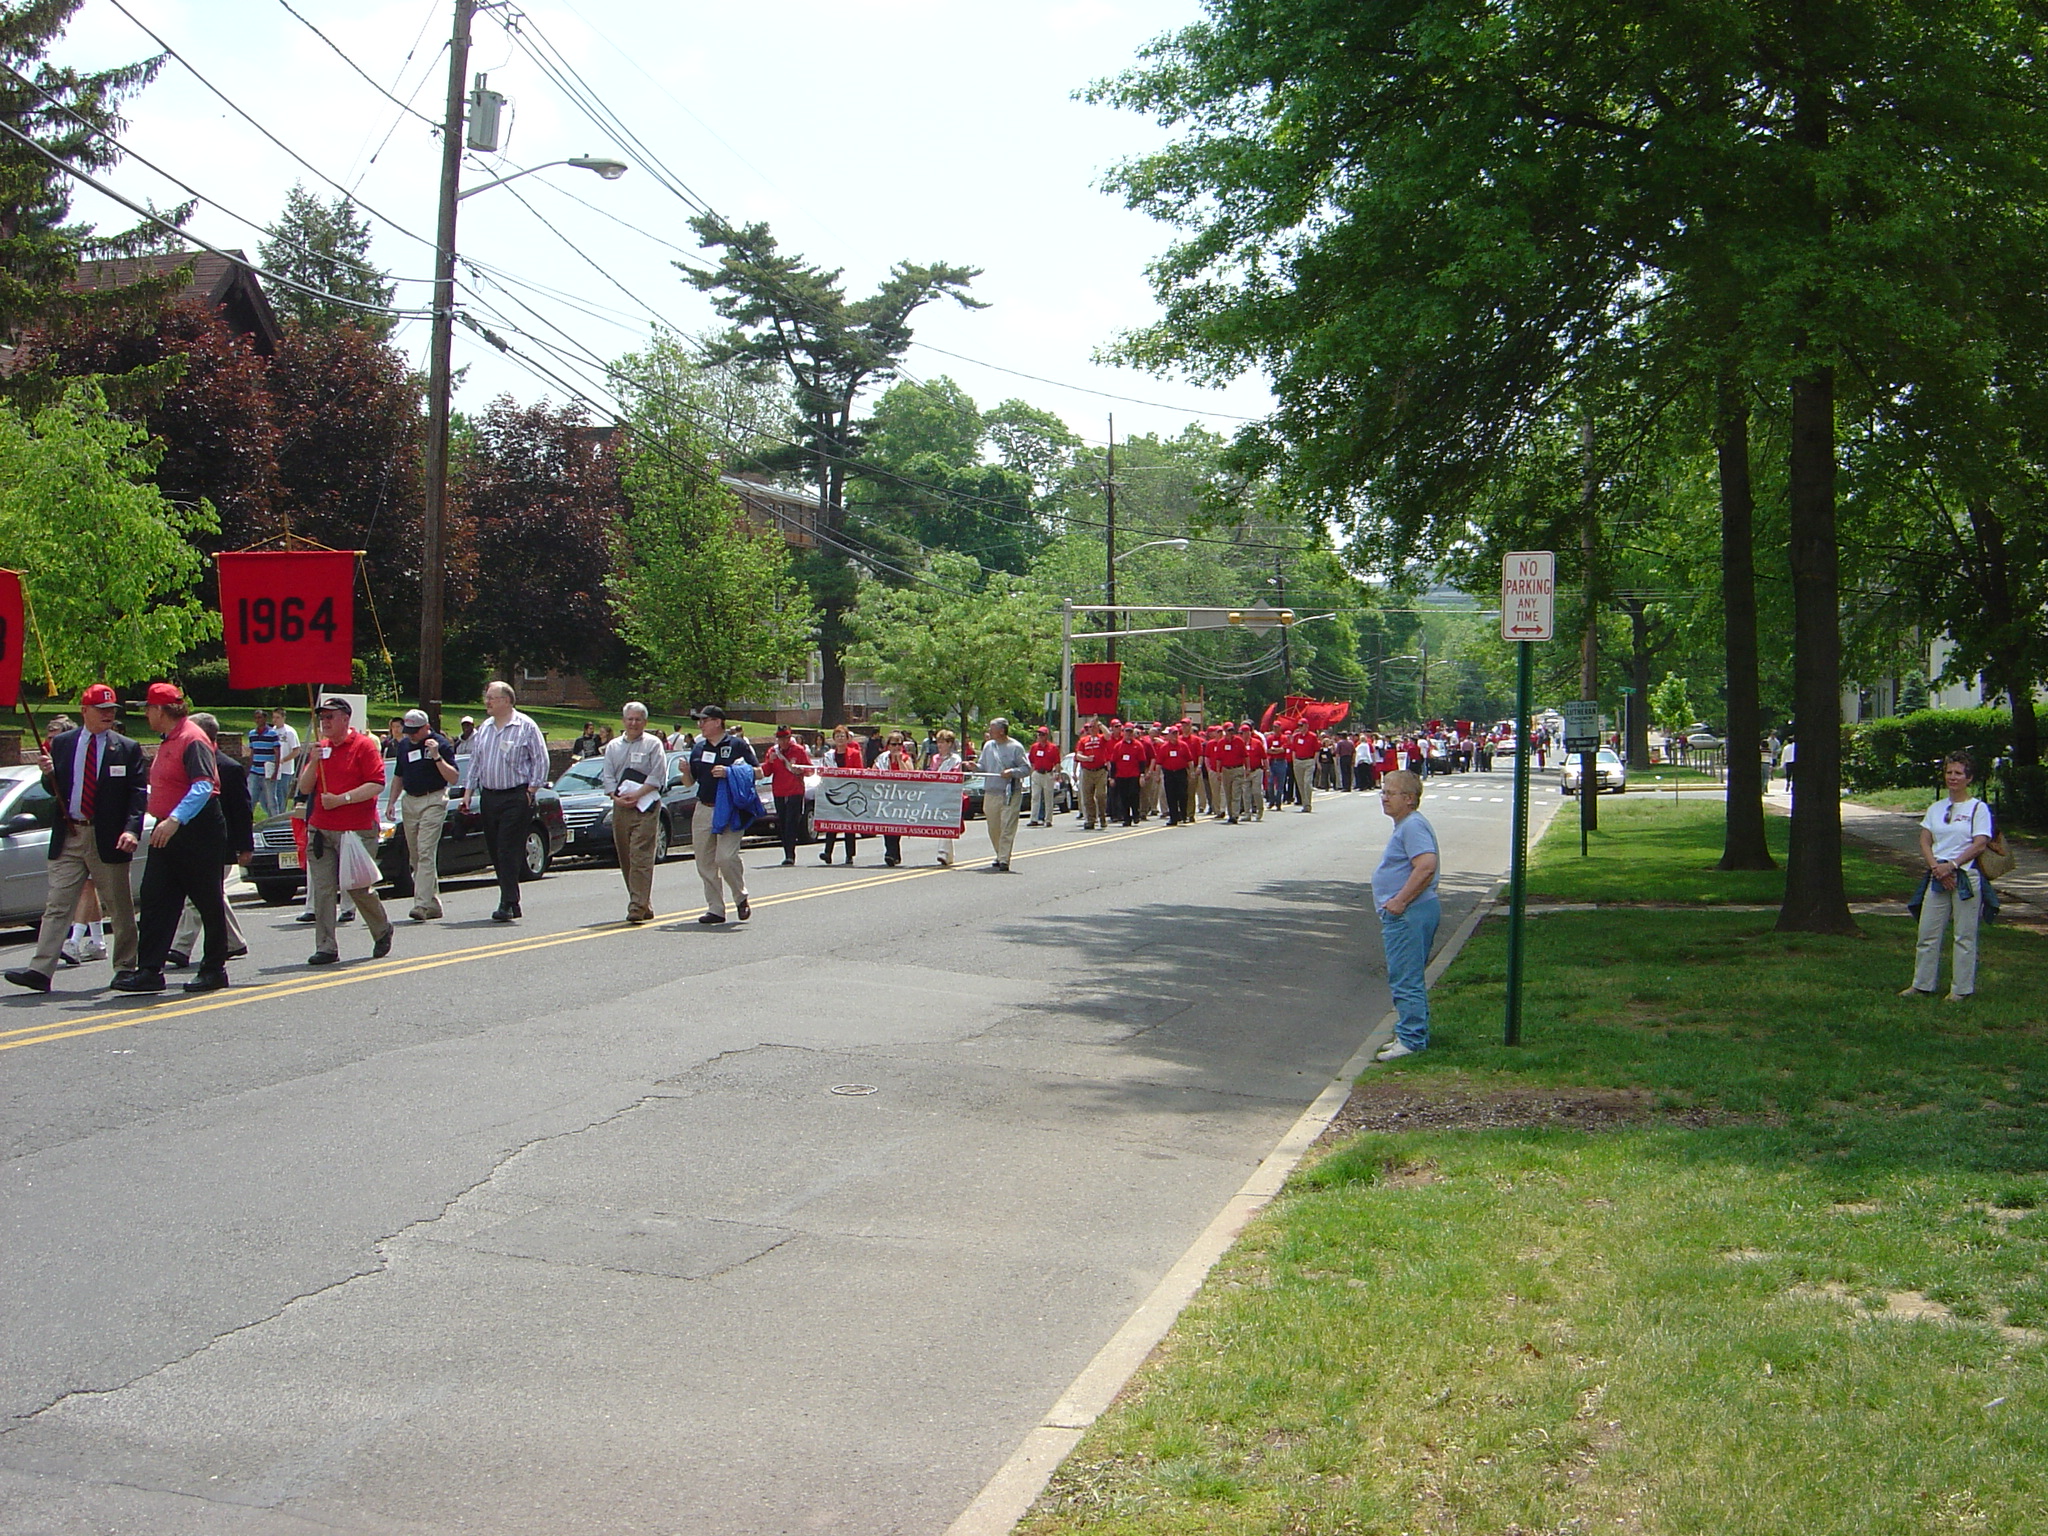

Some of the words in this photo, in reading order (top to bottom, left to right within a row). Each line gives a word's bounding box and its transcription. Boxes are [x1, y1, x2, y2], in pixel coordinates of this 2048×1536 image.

[1519, 560, 1538, 577] NO
[1506, 578, 1551, 595] PARKING
[1518, 598, 1538, 609] ANY
[238, 596, 338, 645] 1964
[1516, 611, 1539, 622] TIME
[103, 691, 112, 700] R
[1079, 681, 1114, 699] 1966
[939, 772, 959, 781] Jersey
[871, 782, 925, 801] Silver
[875, 802, 950, 823] Knights
[820, 822, 852, 831] RUTGERS
[852, 823, 874, 831] STAFF
[875, 824, 908, 834] RETIREES
